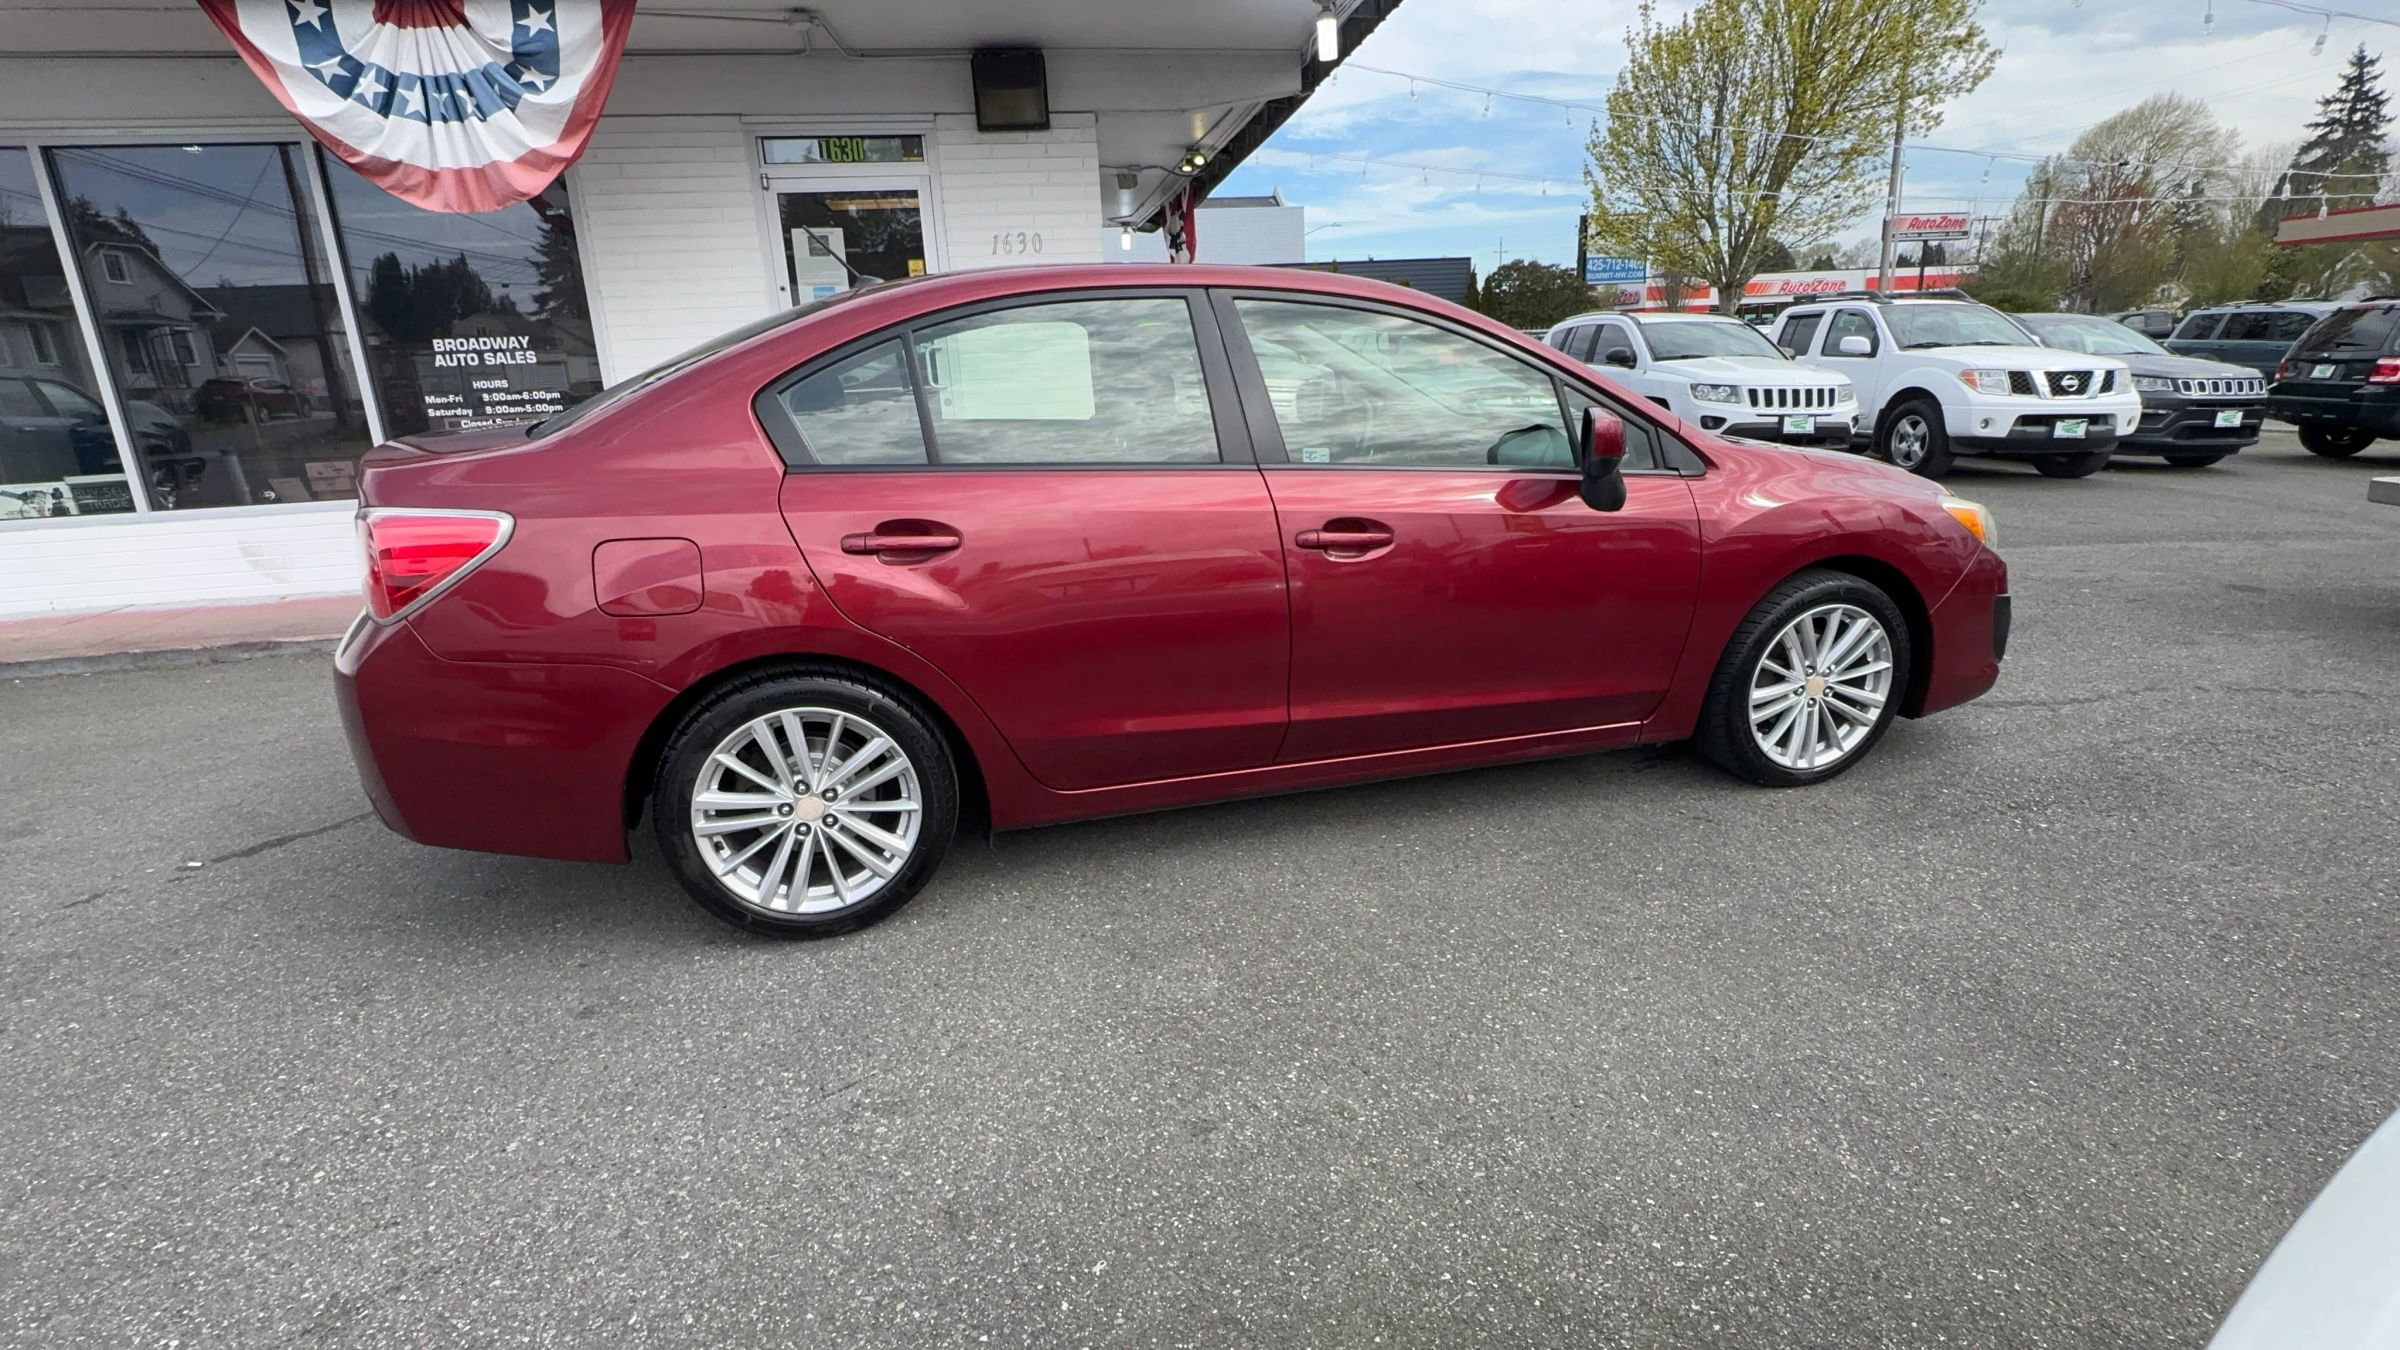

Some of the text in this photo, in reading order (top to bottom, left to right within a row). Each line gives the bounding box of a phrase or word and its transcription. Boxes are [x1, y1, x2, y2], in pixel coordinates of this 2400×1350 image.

[819, 137, 864, 162] 1630
[1907, 216, 1967, 230] AutoZone
[992, 231, 1043, 256] 1630
[1778, 280, 1847, 294] AutoZone
[432, 336, 530, 351] BROADWAY
[434, 351, 537, 367] AUTO SALES
[472, 379, 509, 389] HOURS
[425, 391, 561, 404] Mon-Fri 9:00am-6:00pm
[427, 404, 563, 417] Saturday 9:00am-5:00pm
